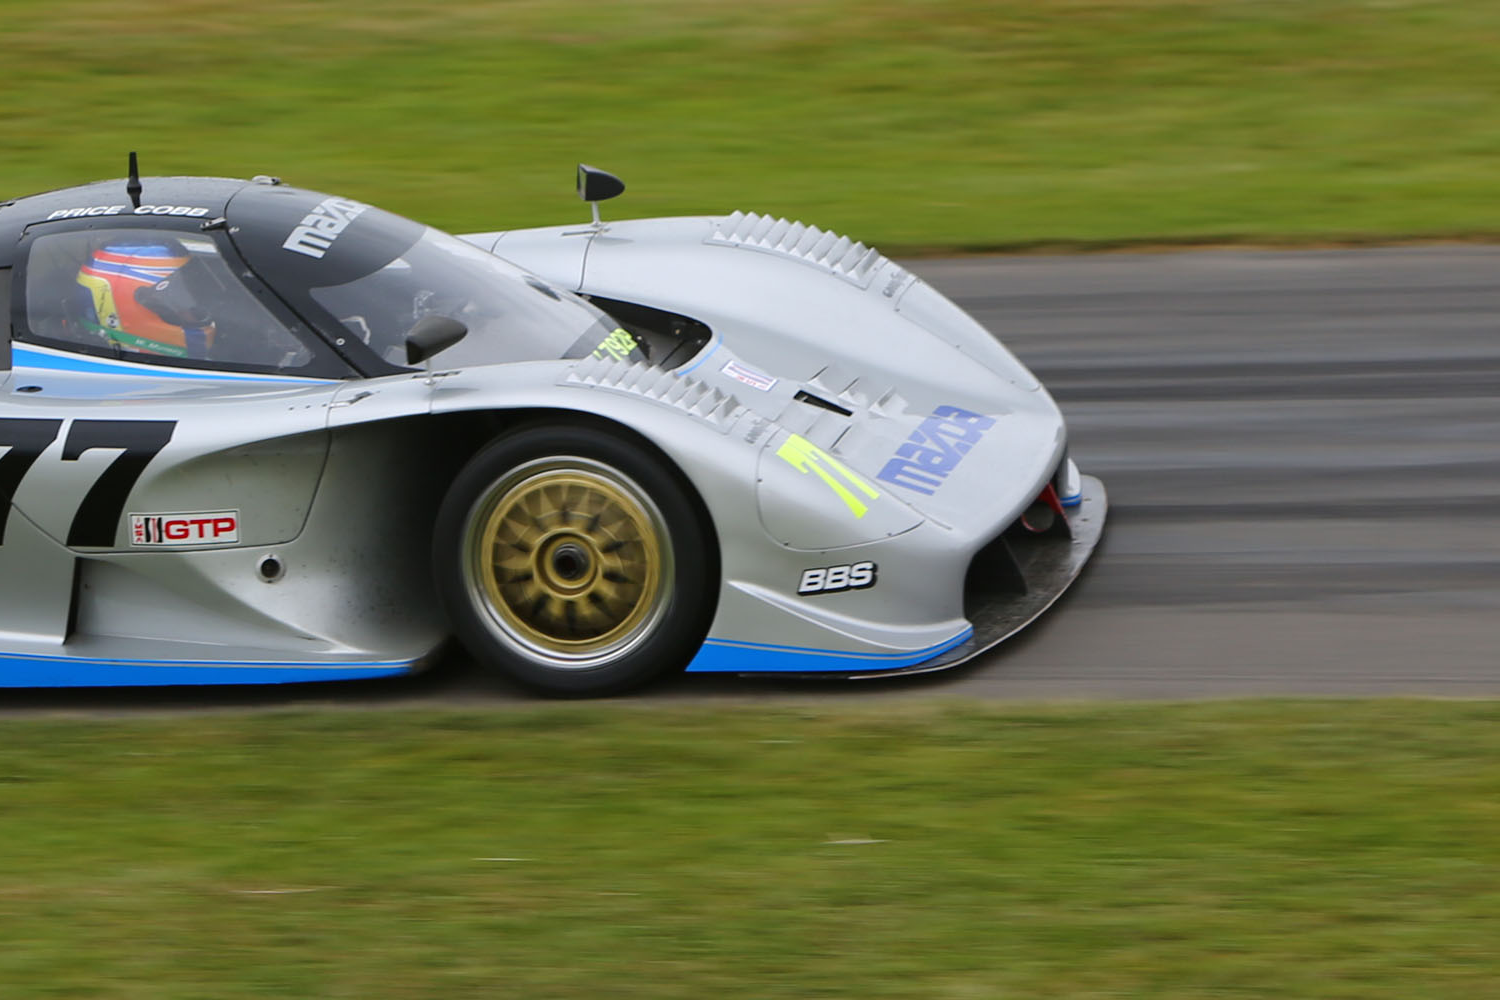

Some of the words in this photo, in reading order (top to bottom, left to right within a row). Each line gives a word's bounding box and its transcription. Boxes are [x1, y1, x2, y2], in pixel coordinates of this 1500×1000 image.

[47, 204, 125, 220] PRICE
[134, 204, 209, 217] COBB
[282, 197, 368, 259] mazd
[876, 405, 997, 496] mazda
[164, 517, 237, 540] GTP
[798, 561, 875, 593] BBS
